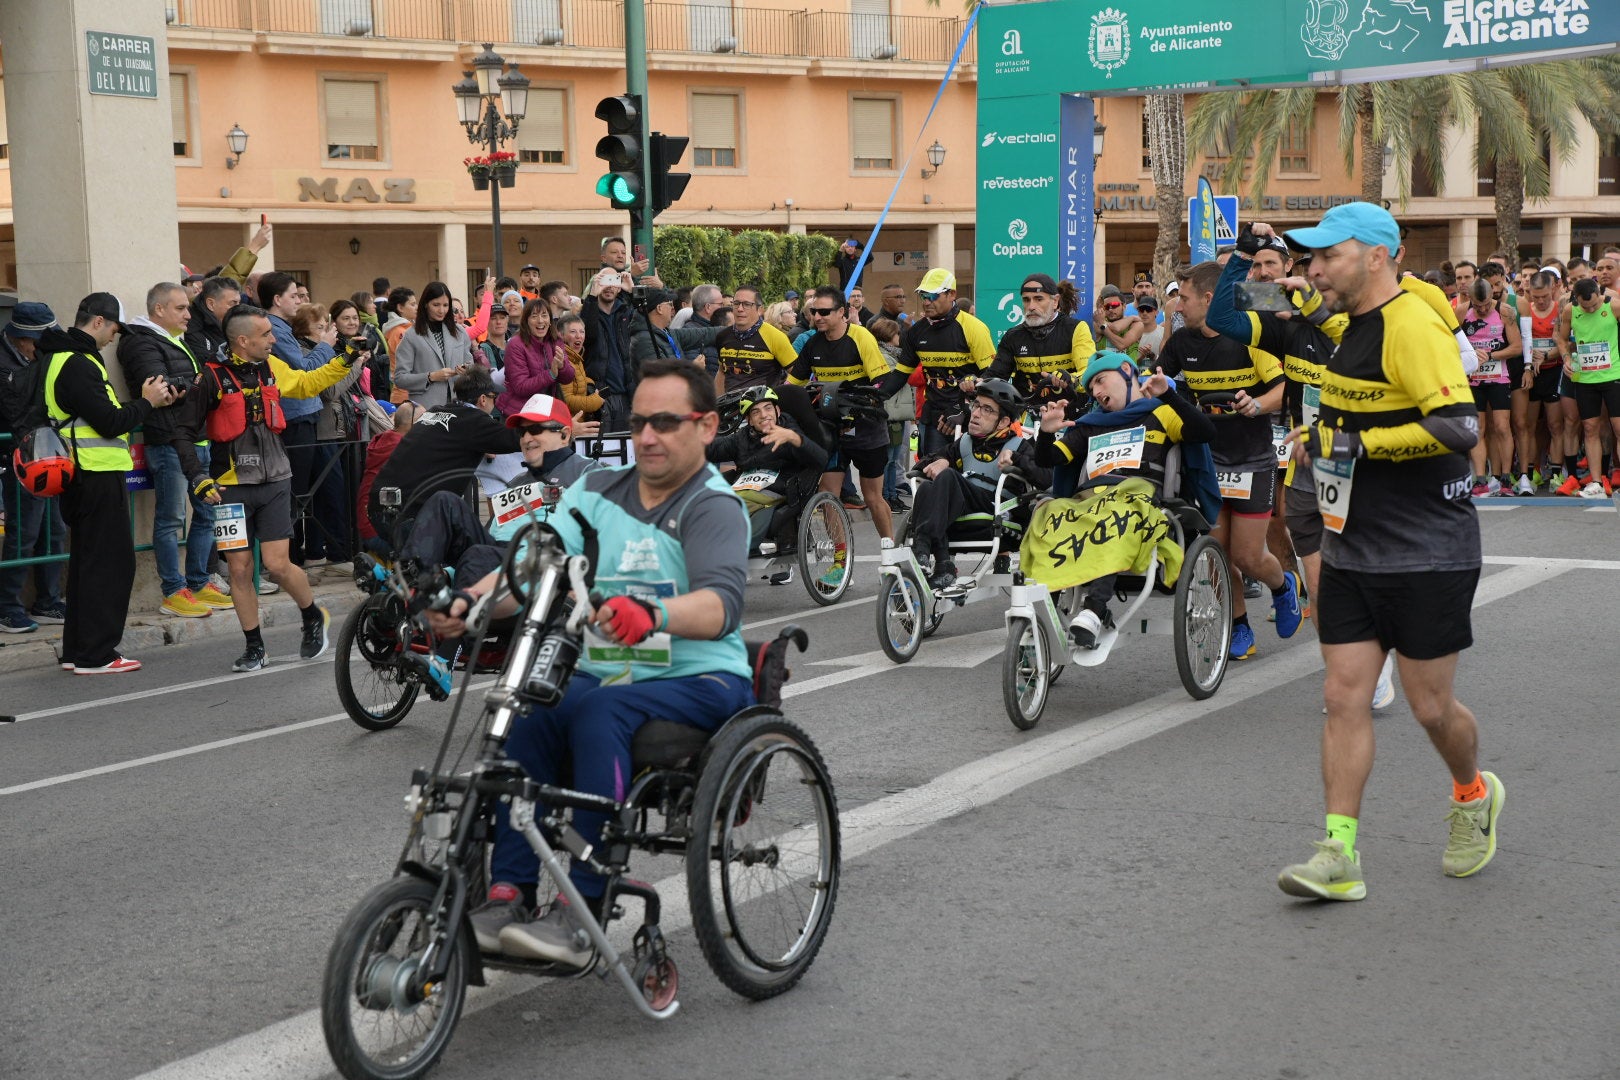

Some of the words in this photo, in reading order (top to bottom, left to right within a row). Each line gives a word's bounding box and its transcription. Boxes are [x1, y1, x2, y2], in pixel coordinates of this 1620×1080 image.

[1443, 0, 1533, 20] Elche
[1140, 20, 1233, 39] Ayuntamiento
[1443, 12, 1590, 48] Alicante
[102, 37, 150, 54] CARRER
[1150, 41, 1166, 53] de
[1169, 37, 1222, 51] Alicante
[102, 55, 111, 67] DE
[114, 57, 123, 68] LA
[96, 71, 116, 90] DEL
[119, 74, 151, 93] PALAU
[997, 132, 1056, 144] vectalia
[298, 177, 416, 203] MAZ
[1066, 146, 1078, 281] NTEMAR
[992, 243, 1043, 258] Coplaca
[1582, 353, 1606, 364] 3574
[1477, 364, 1497, 373] 827
[1095, 447, 1132, 464] 2812
[499, 484, 532, 507] 3678
[213, 524, 238, 538] 816
